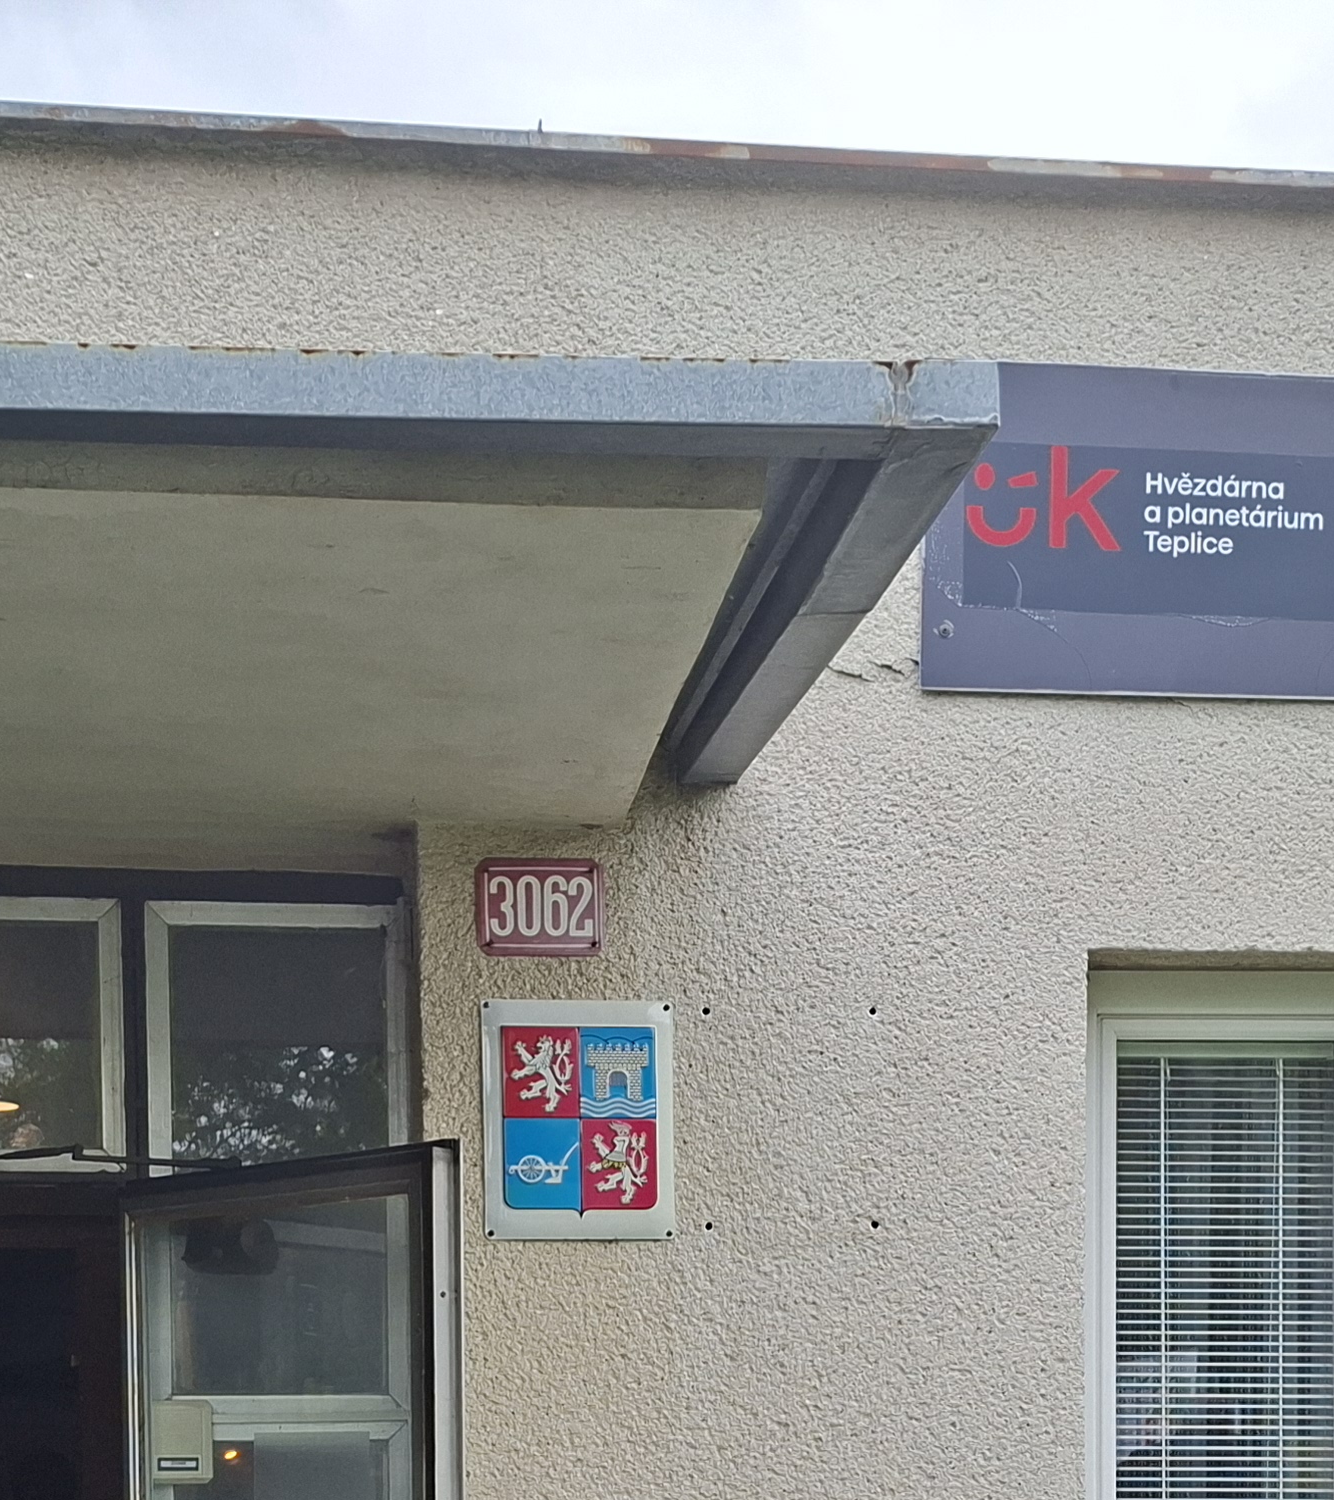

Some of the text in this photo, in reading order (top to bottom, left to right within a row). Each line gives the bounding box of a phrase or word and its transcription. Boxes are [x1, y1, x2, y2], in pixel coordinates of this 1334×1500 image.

[1145, 471, 1286, 500] Hvězdárna
[1144, 502, 1324, 532] a planetárium
[1144, 530, 1234, 558] Teplice
[489, 874, 594, 938] 3062
